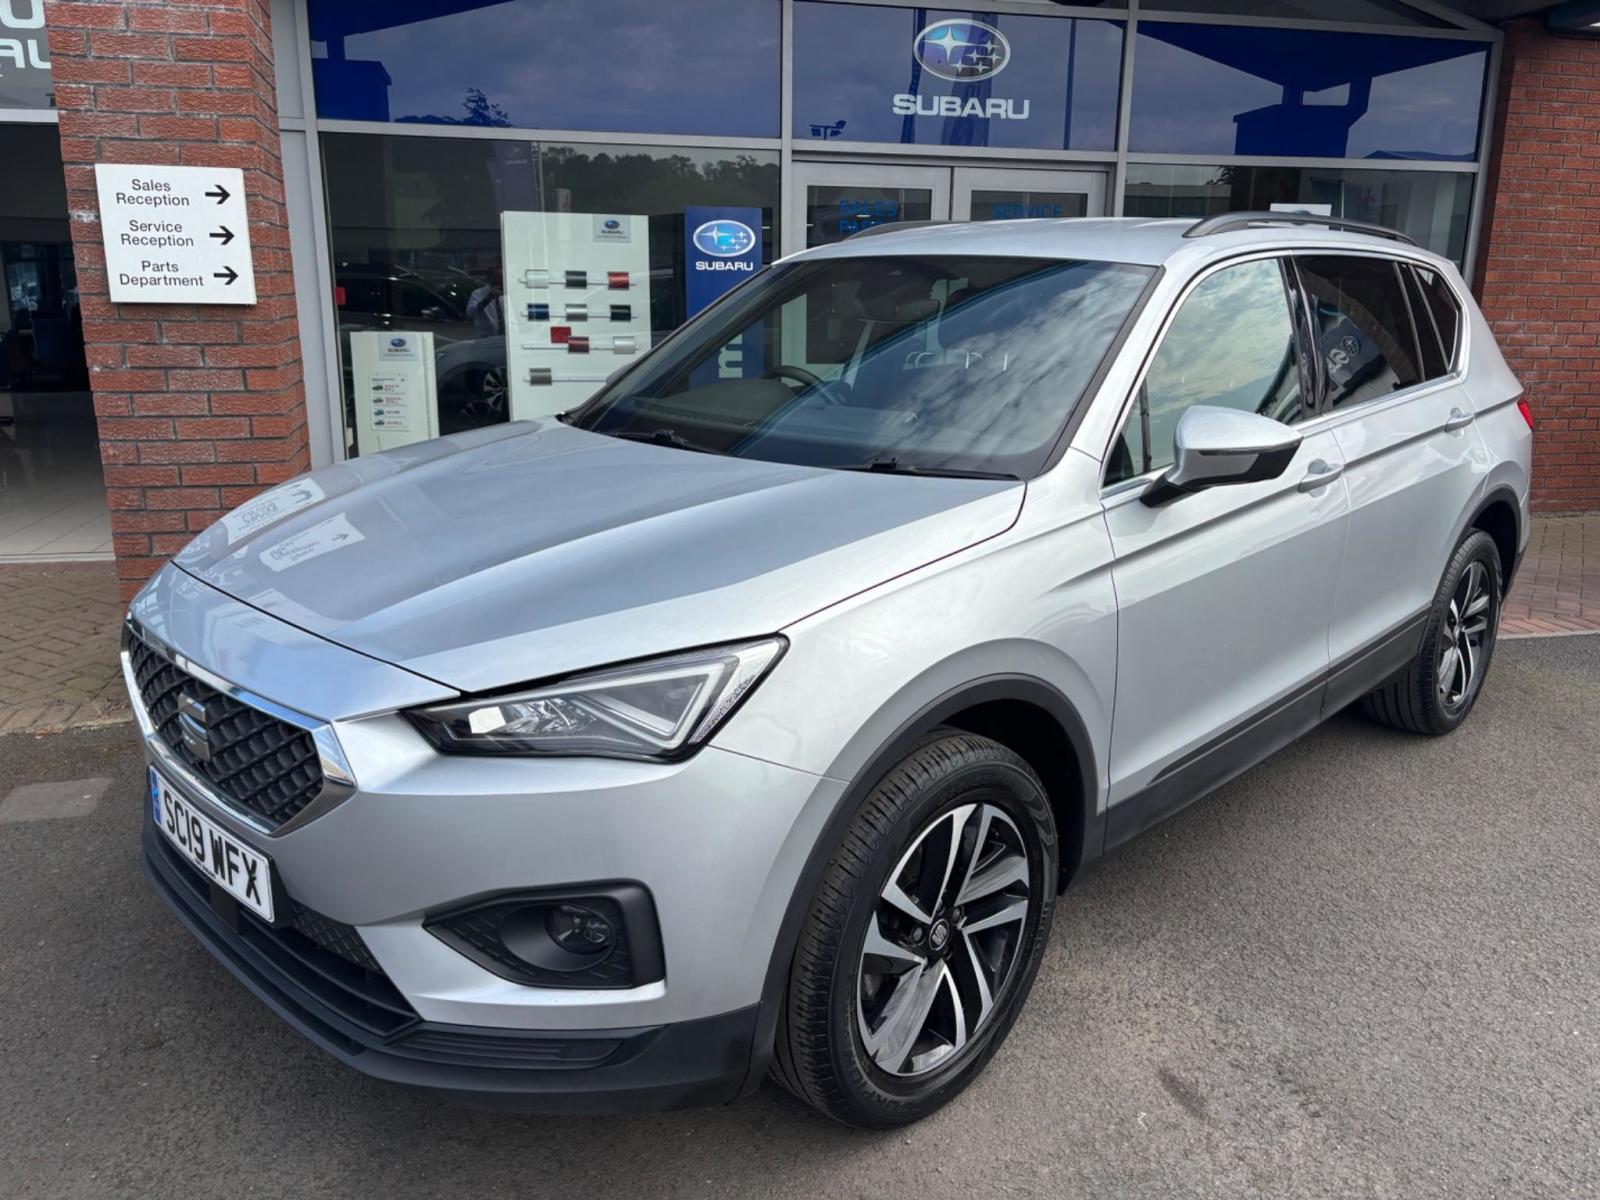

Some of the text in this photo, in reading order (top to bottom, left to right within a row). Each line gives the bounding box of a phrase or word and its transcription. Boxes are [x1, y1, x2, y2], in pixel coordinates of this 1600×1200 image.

[892, 93, 1030, 120] SUBARU
[131, 178, 172, 192] Sales
[116, 193, 190, 208] Reception
[838, 200, 898, 218] SALES
[991, 203, 1064, 219] SERVICE
[128, 219, 183, 233] Service
[120, 234, 194, 249] Reception
[141, 260, 179, 273] Parts
[695, 261, 754, 271] SUBARU
[119, 273, 204, 288] Department
[163, 789, 262, 907] SC19 WFX
